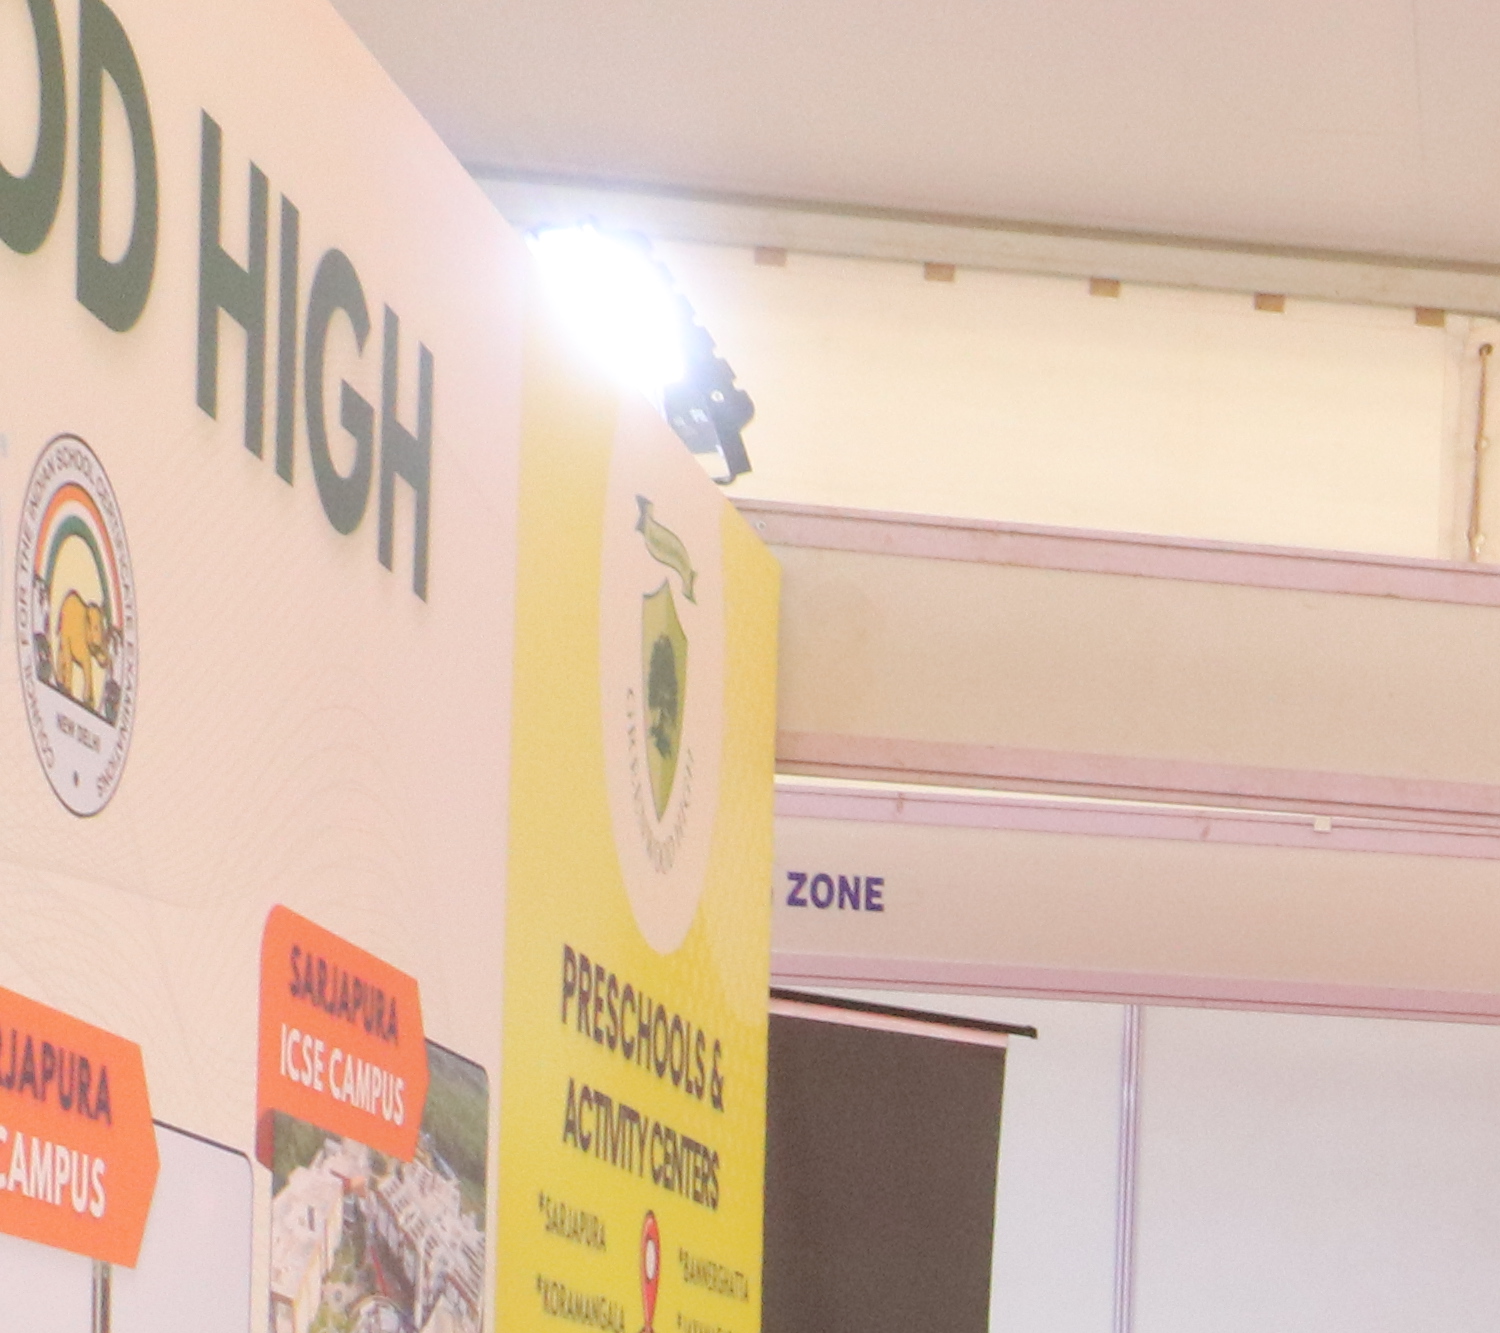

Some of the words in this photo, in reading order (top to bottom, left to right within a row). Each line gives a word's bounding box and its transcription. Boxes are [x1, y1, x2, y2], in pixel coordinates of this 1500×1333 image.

[197, 107, 434, 604] HIGH
[786, 871, 886, 912] ZONE
[288, 943, 400, 1047] SARJAPURA
[562, 943, 706, 1101] PRESCHOOLS
[710, 1037, 725, 1113] &
[0, 1027, 112, 1127] JAPURA
[280, 1022, 325, 1095] ICSE
[327, 1046, 406, 1127] CAMPUS
[562, 1075, 648, 1179] ACTIVITY
[650, 1119, 720, 1212] CENTERS
